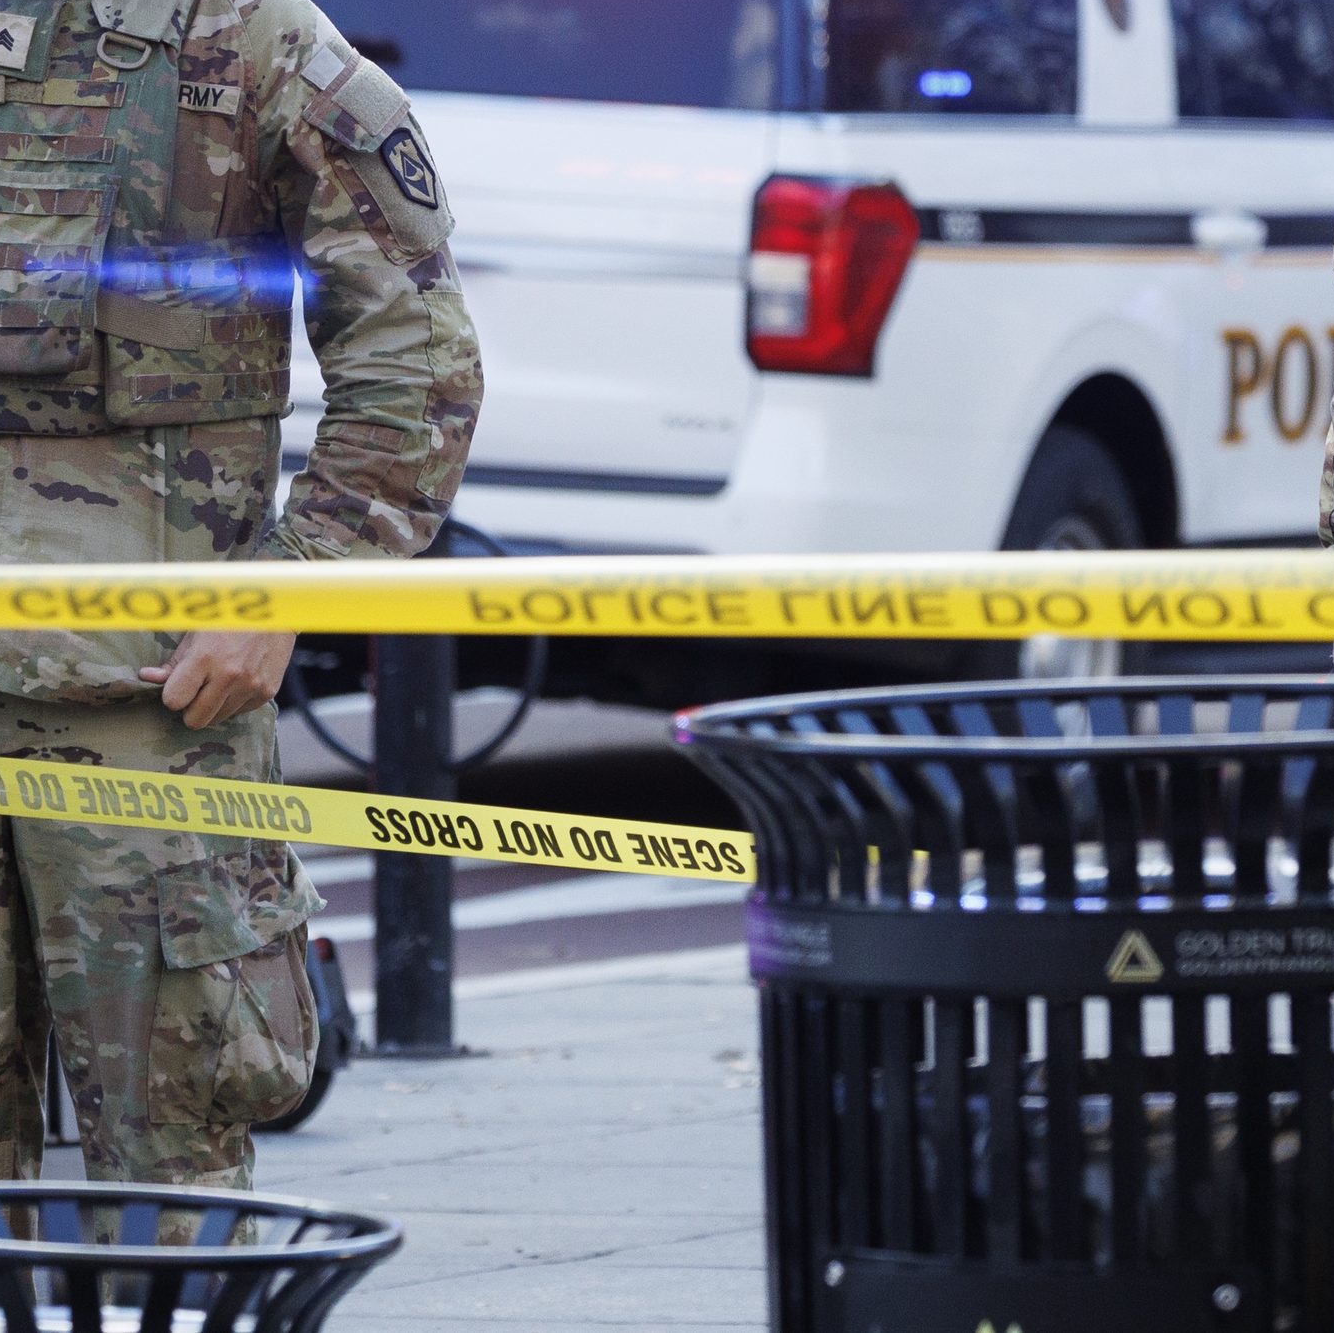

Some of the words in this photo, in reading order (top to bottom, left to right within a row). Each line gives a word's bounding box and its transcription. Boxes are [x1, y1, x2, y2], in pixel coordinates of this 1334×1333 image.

[177, 83, 225, 107] RMY
[17, 770, 67, 812] DO
[72, 776, 189, 824] SCENE
[194, 787, 313, 834] CRIME
[364, 806, 483, 851] CROSS
[493, 819, 563, 859] NOT
[570, 825, 622, 863] DO
[627, 832, 746, 874] SCENE
